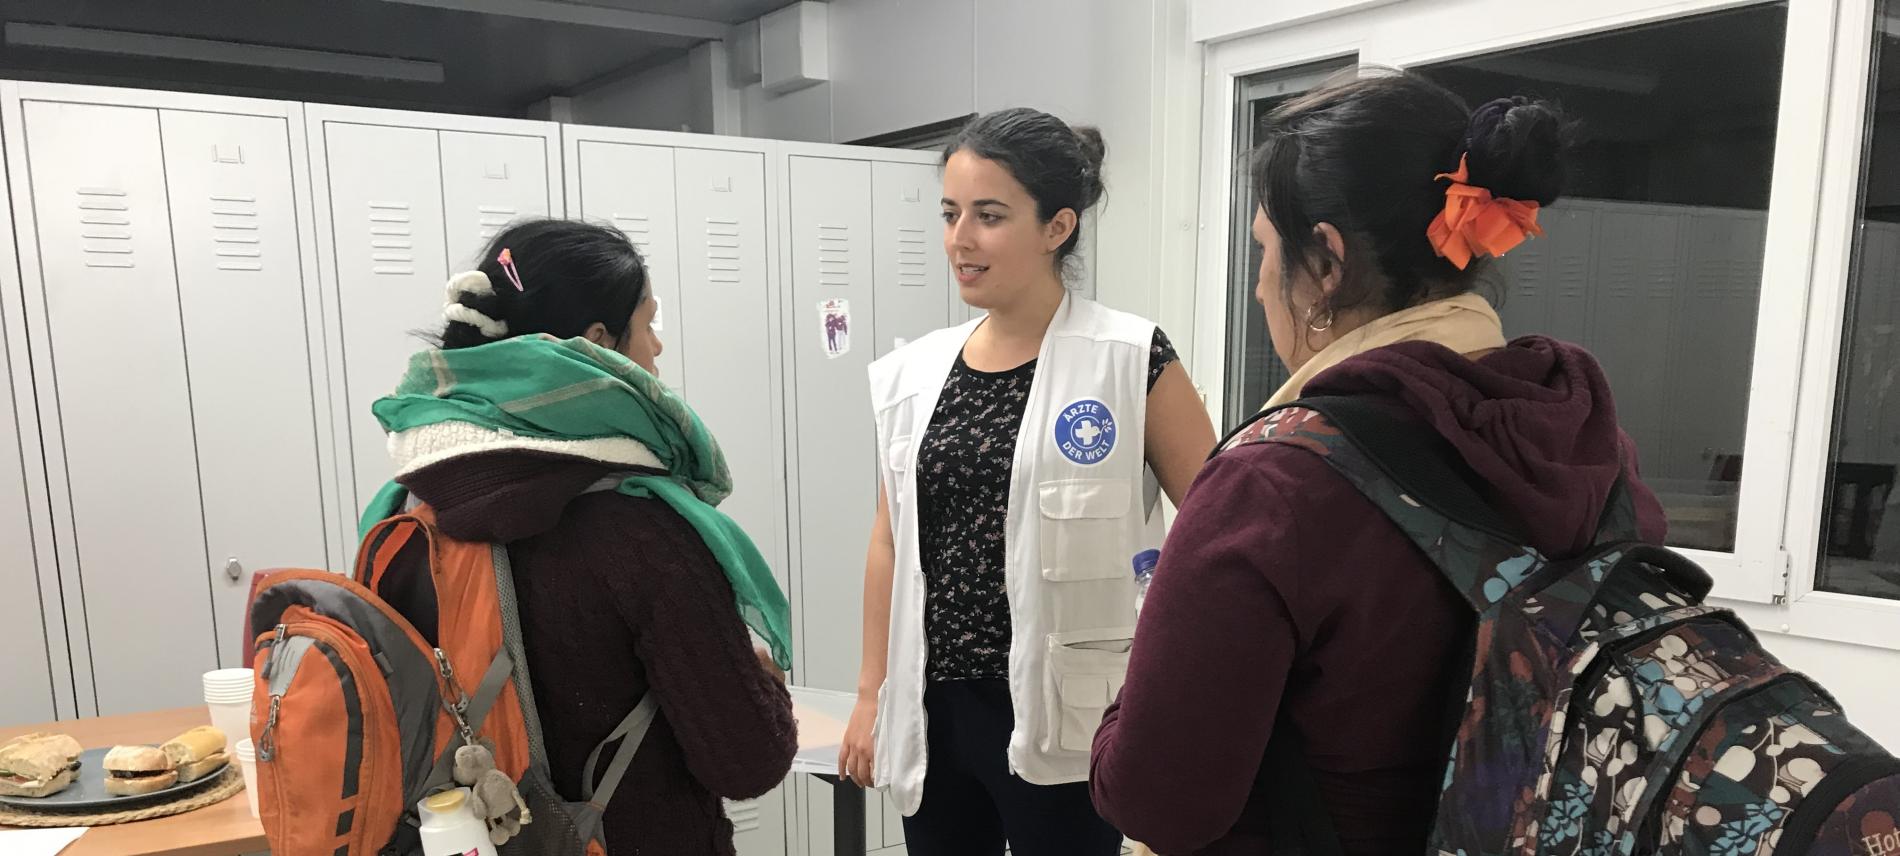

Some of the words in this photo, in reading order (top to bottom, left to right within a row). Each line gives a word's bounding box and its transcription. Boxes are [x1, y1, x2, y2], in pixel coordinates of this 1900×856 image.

[1063, 404, 1099, 423] ÄRZTE
[1063, 441, 1083, 460] DER
[1085, 440, 1110, 460] WELT
